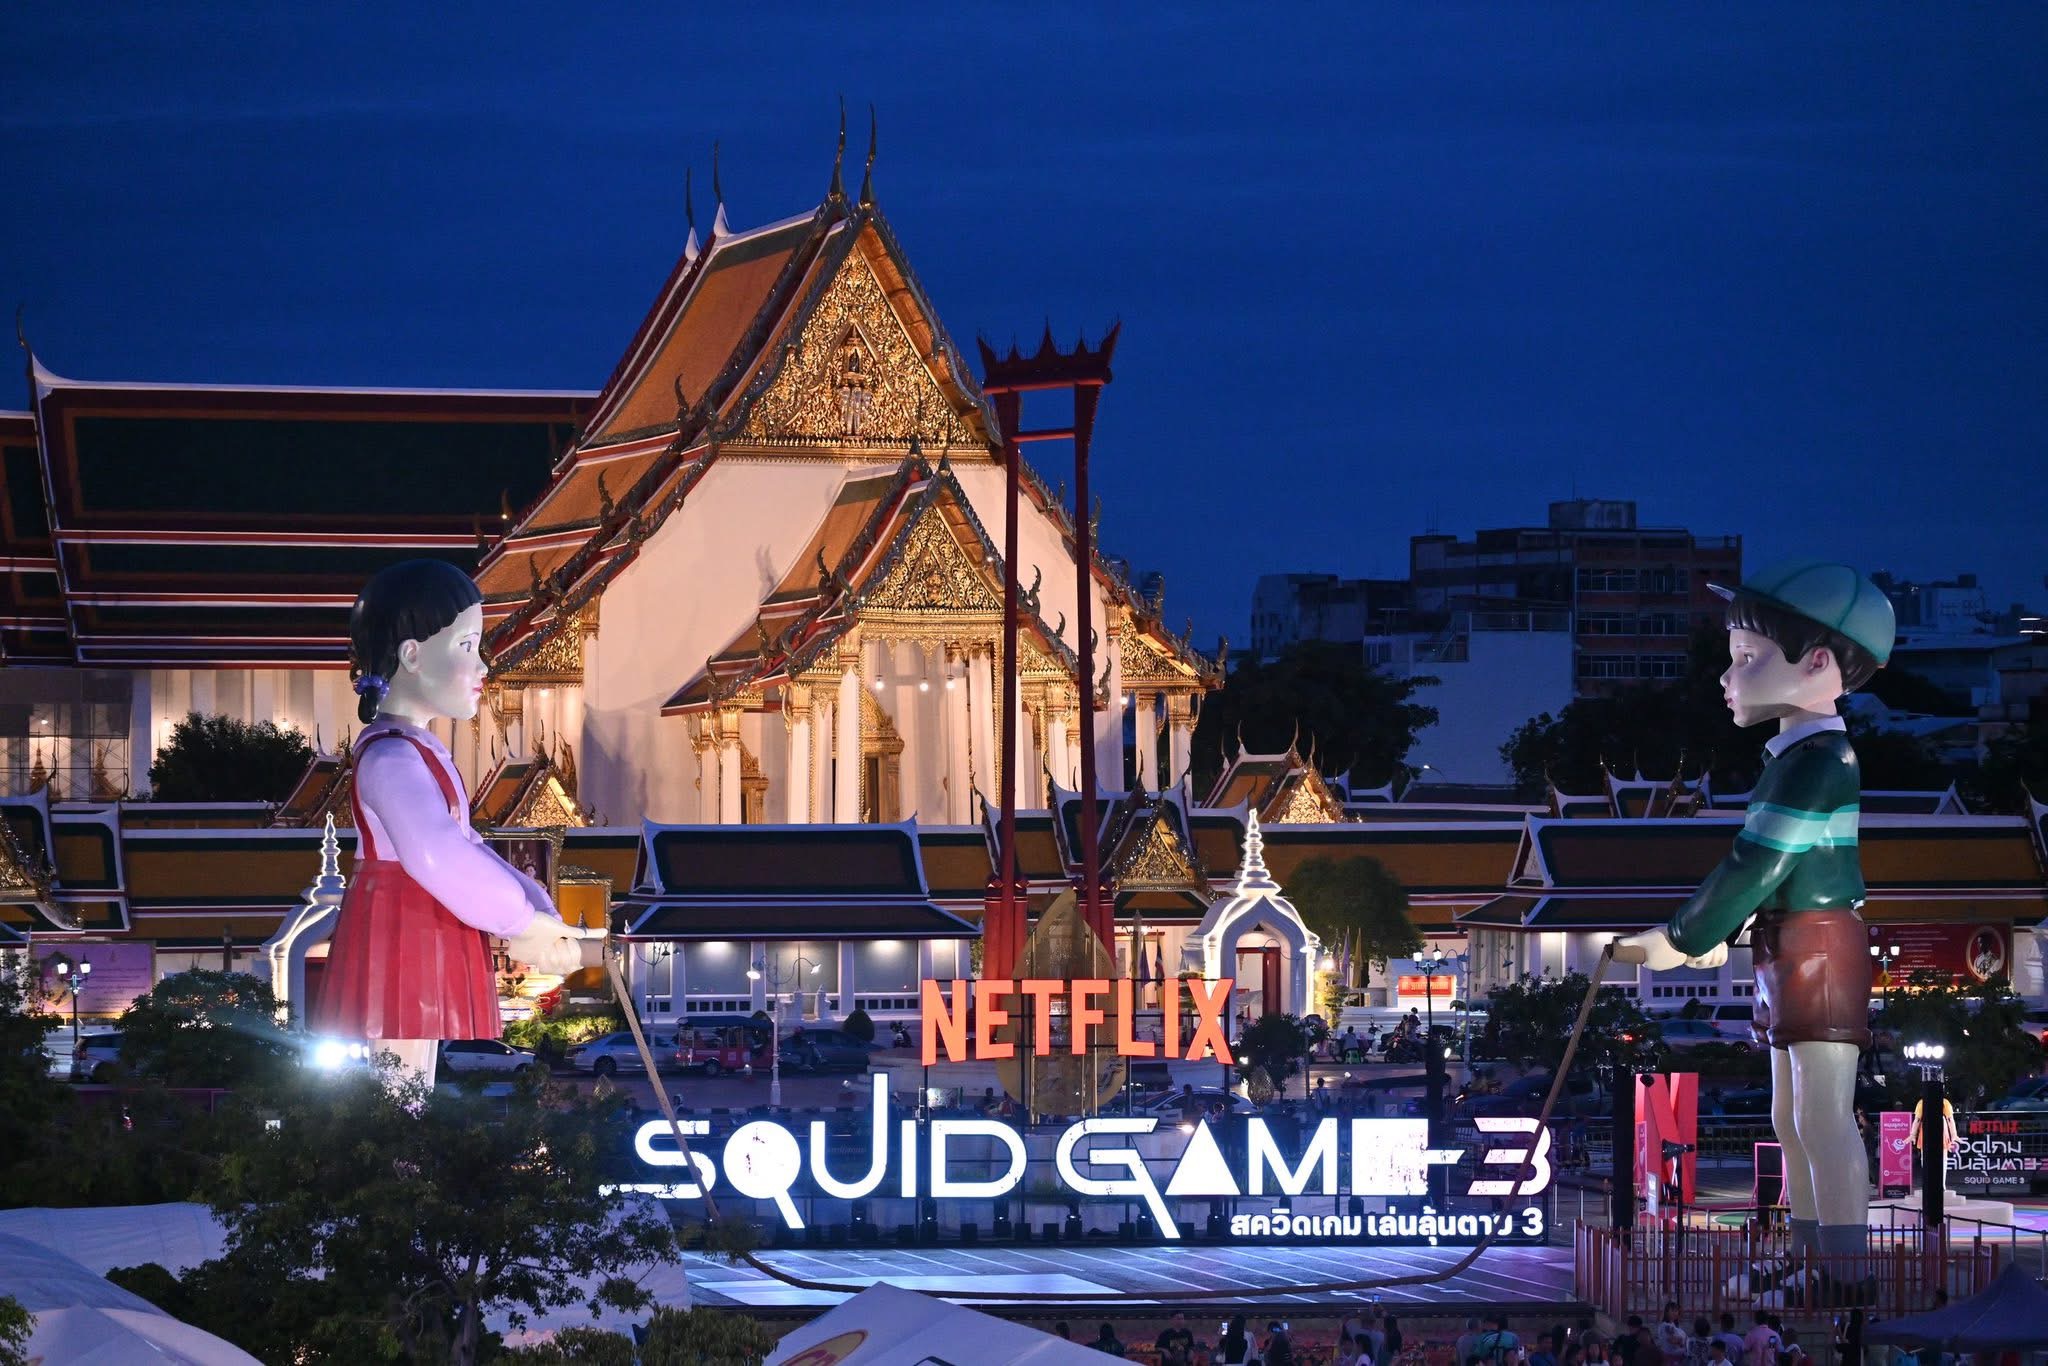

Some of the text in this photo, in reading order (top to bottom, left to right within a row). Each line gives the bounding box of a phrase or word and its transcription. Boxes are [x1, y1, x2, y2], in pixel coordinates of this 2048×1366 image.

[921, 978, 1235, 1067] NETFLIX
[1969, 1120, 2018, 1135] NETFLIX
[598, 1073, 1552, 1239] SQUID GAME 3
[1964, 1177, 1991, 1185] SQUID
[1992, 1177, 2018, 1185] GAME
[1230, 1206, 1544, 1246] สควิดเกม เล่นลุ้นตาย 3
